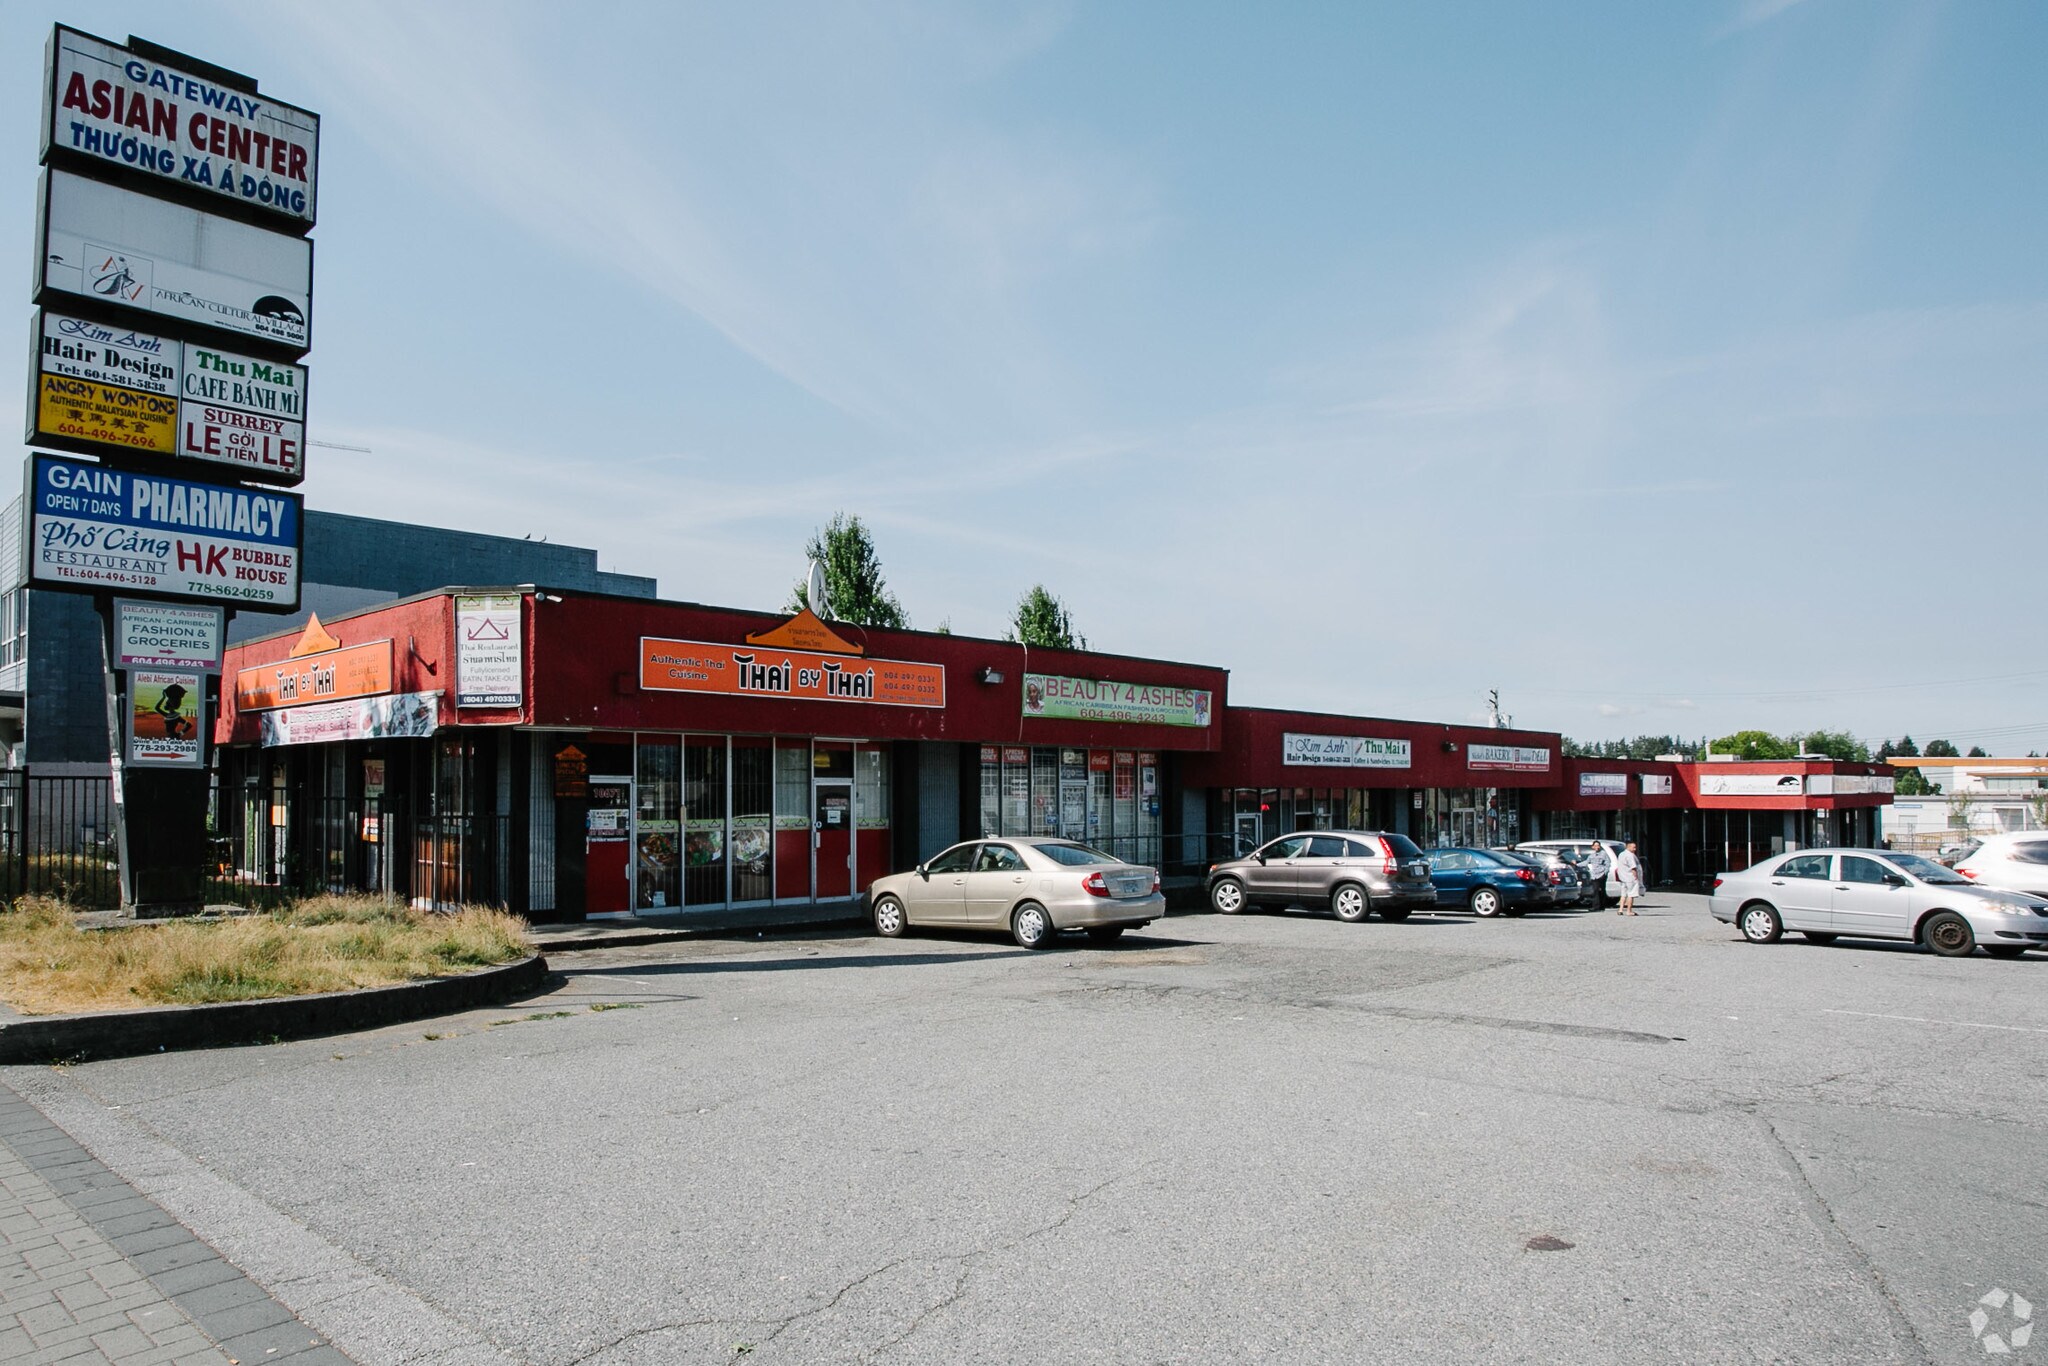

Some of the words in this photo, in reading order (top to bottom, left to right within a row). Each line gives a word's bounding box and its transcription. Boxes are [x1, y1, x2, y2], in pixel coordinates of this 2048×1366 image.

[124, 60, 261, 121] GATEWAY
[62, 71, 178, 142] ASIAN
[188, 111, 308, 183] CENTER
[181, 155, 213, 186] XÁ
[219, 164, 235, 193] Á
[240, 175, 306, 213] ĐÔNG
[156, 290, 205, 308] AFRICAN
[208, 303, 265, 324] CULTURAL
[266, 317, 304, 334] VILLAGE
[59, 319, 113, 342] Kim
[115, 332, 162, 353] Anh
[43, 335, 97, 363] Hair
[104, 348, 174, 382] Design
[196, 350, 245, 377] Thu
[251, 362, 294, 387] Mai
[55, 362, 81, 376] Tel:
[84, 368, 166, 392] 604-581-5838
[45, 377, 97, 400] ANGRY
[102, 388, 176, 415] WONTONS
[185, 373, 228, 401] CAFE
[232, 380, 276, 411] BÁNH
[280, 390, 299, 415] MÌ
[50, 395, 94, 411] AUTHENTIC
[95, 401, 138, 419] MALAYSIAN
[139, 411, 169, 425] CUISINE
[204, 407, 285, 434] SURREY
[58, 423, 156, 448] 604-496-7696
[47, 465, 122, 497] GAIN
[46, 493, 79, 511] OPEN
[82, 498, 89, 513] 7
[91, 500, 122, 517] DAYS
[132, 478, 285, 538] PHARMACY
[43, 551, 168, 574] RESTAURANT
[176, 539, 230, 577] HK
[232, 547, 292, 568] BUBBLE
[57, 566, 157, 586] TEL:604-496-5128
[235, 566, 288, 586] HOUSE
[187, 581, 275, 600] 778-862-0259
[122, 606, 167, 616] BEAUTY
[179, 610, 215, 619] ASHES
[122, 615, 162, 624] AFRICAN
[128, 636, 210, 650] GROCERIES
[132, 624, 194, 638] FASHION
[197, 628, 207, 638] &
[650, 654, 701, 668] Authentic
[703, 659, 726, 670] Thai
[153, 675, 175, 684] African
[175, 675, 197, 685] Cuisine
[669, 668, 708, 681] Cuisine
[798, 668, 821, 688] BY
[1045, 678, 1122, 700] BEAUTY
[1125, 685, 1136, 704] 4
[1139, 688, 1194, 708] ASHES
[1054, 700, 1085, 708] AFRICAN
[1080, 708, 1166, 724] 604-496-4243
[133, 744, 197, 752] 778-293-2988
[1364, 740, 1383, 754] Thu
[1385, 740, 1401, 755] Mai
